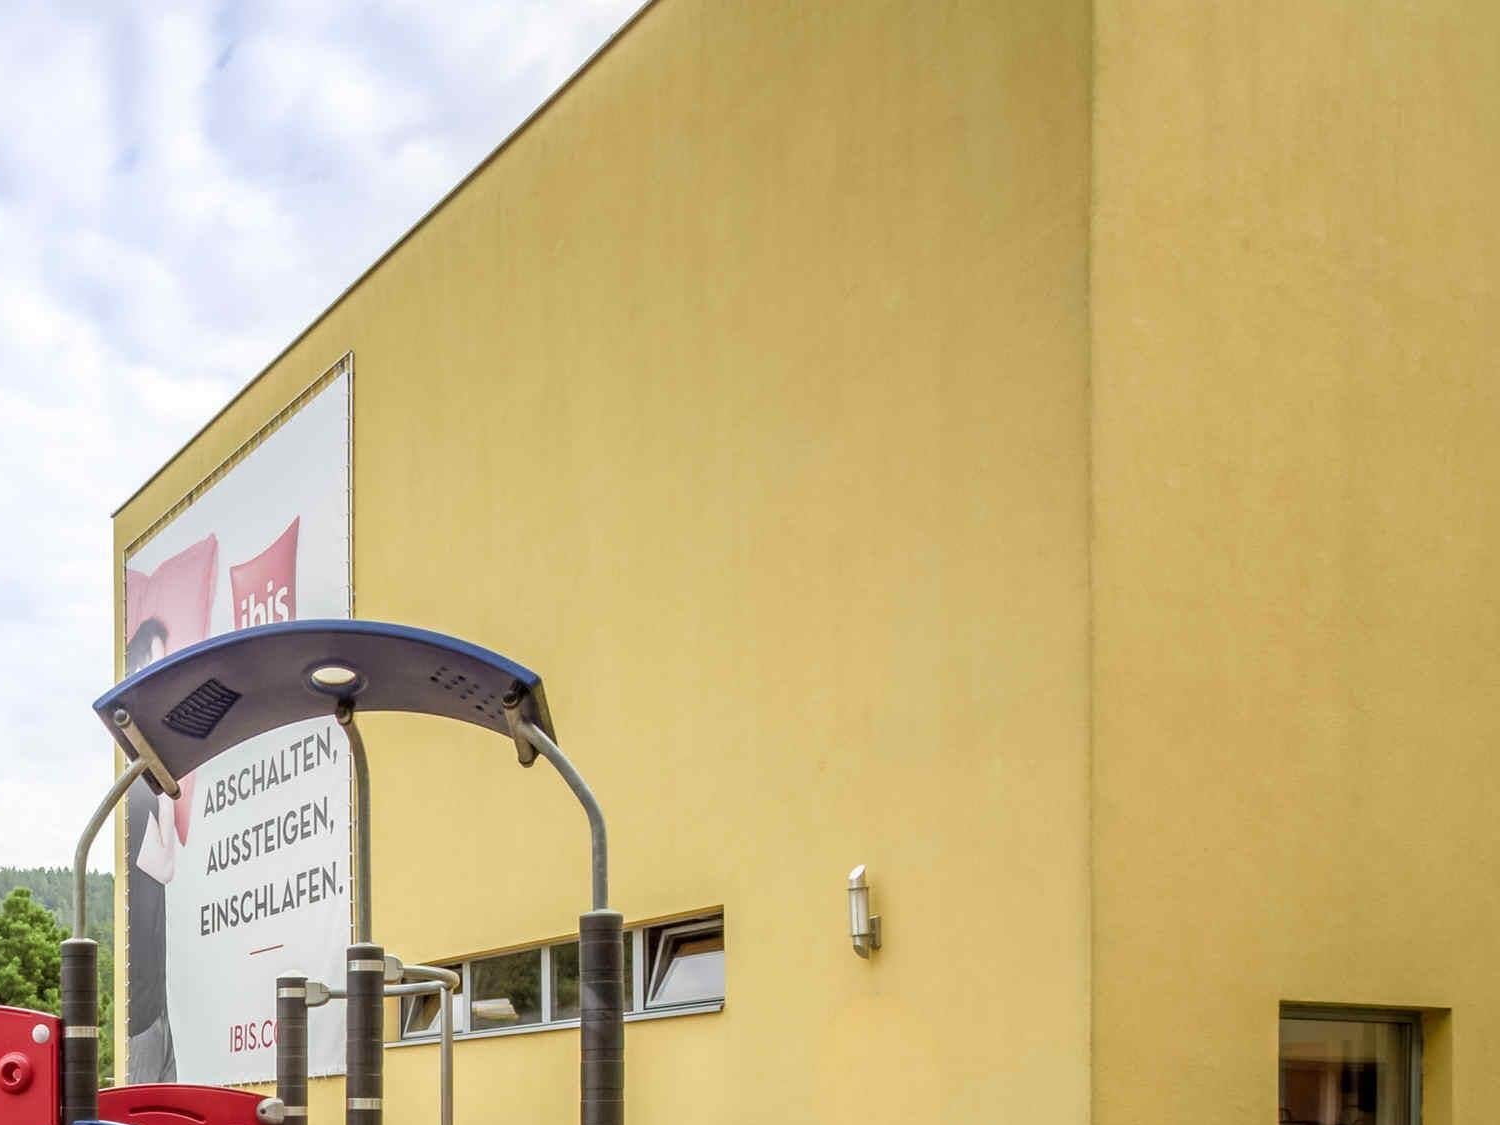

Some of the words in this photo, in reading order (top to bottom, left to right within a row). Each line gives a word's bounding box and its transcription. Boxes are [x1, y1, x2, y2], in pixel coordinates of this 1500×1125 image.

[203, 726, 338, 818] ABSCHALTEN,
[206, 796, 335, 876] AUSSTEIGEN,
[200, 861, 344, 936] EINSCHLAFEN.
[229, 1019, 278, 1053] IBIS.C
